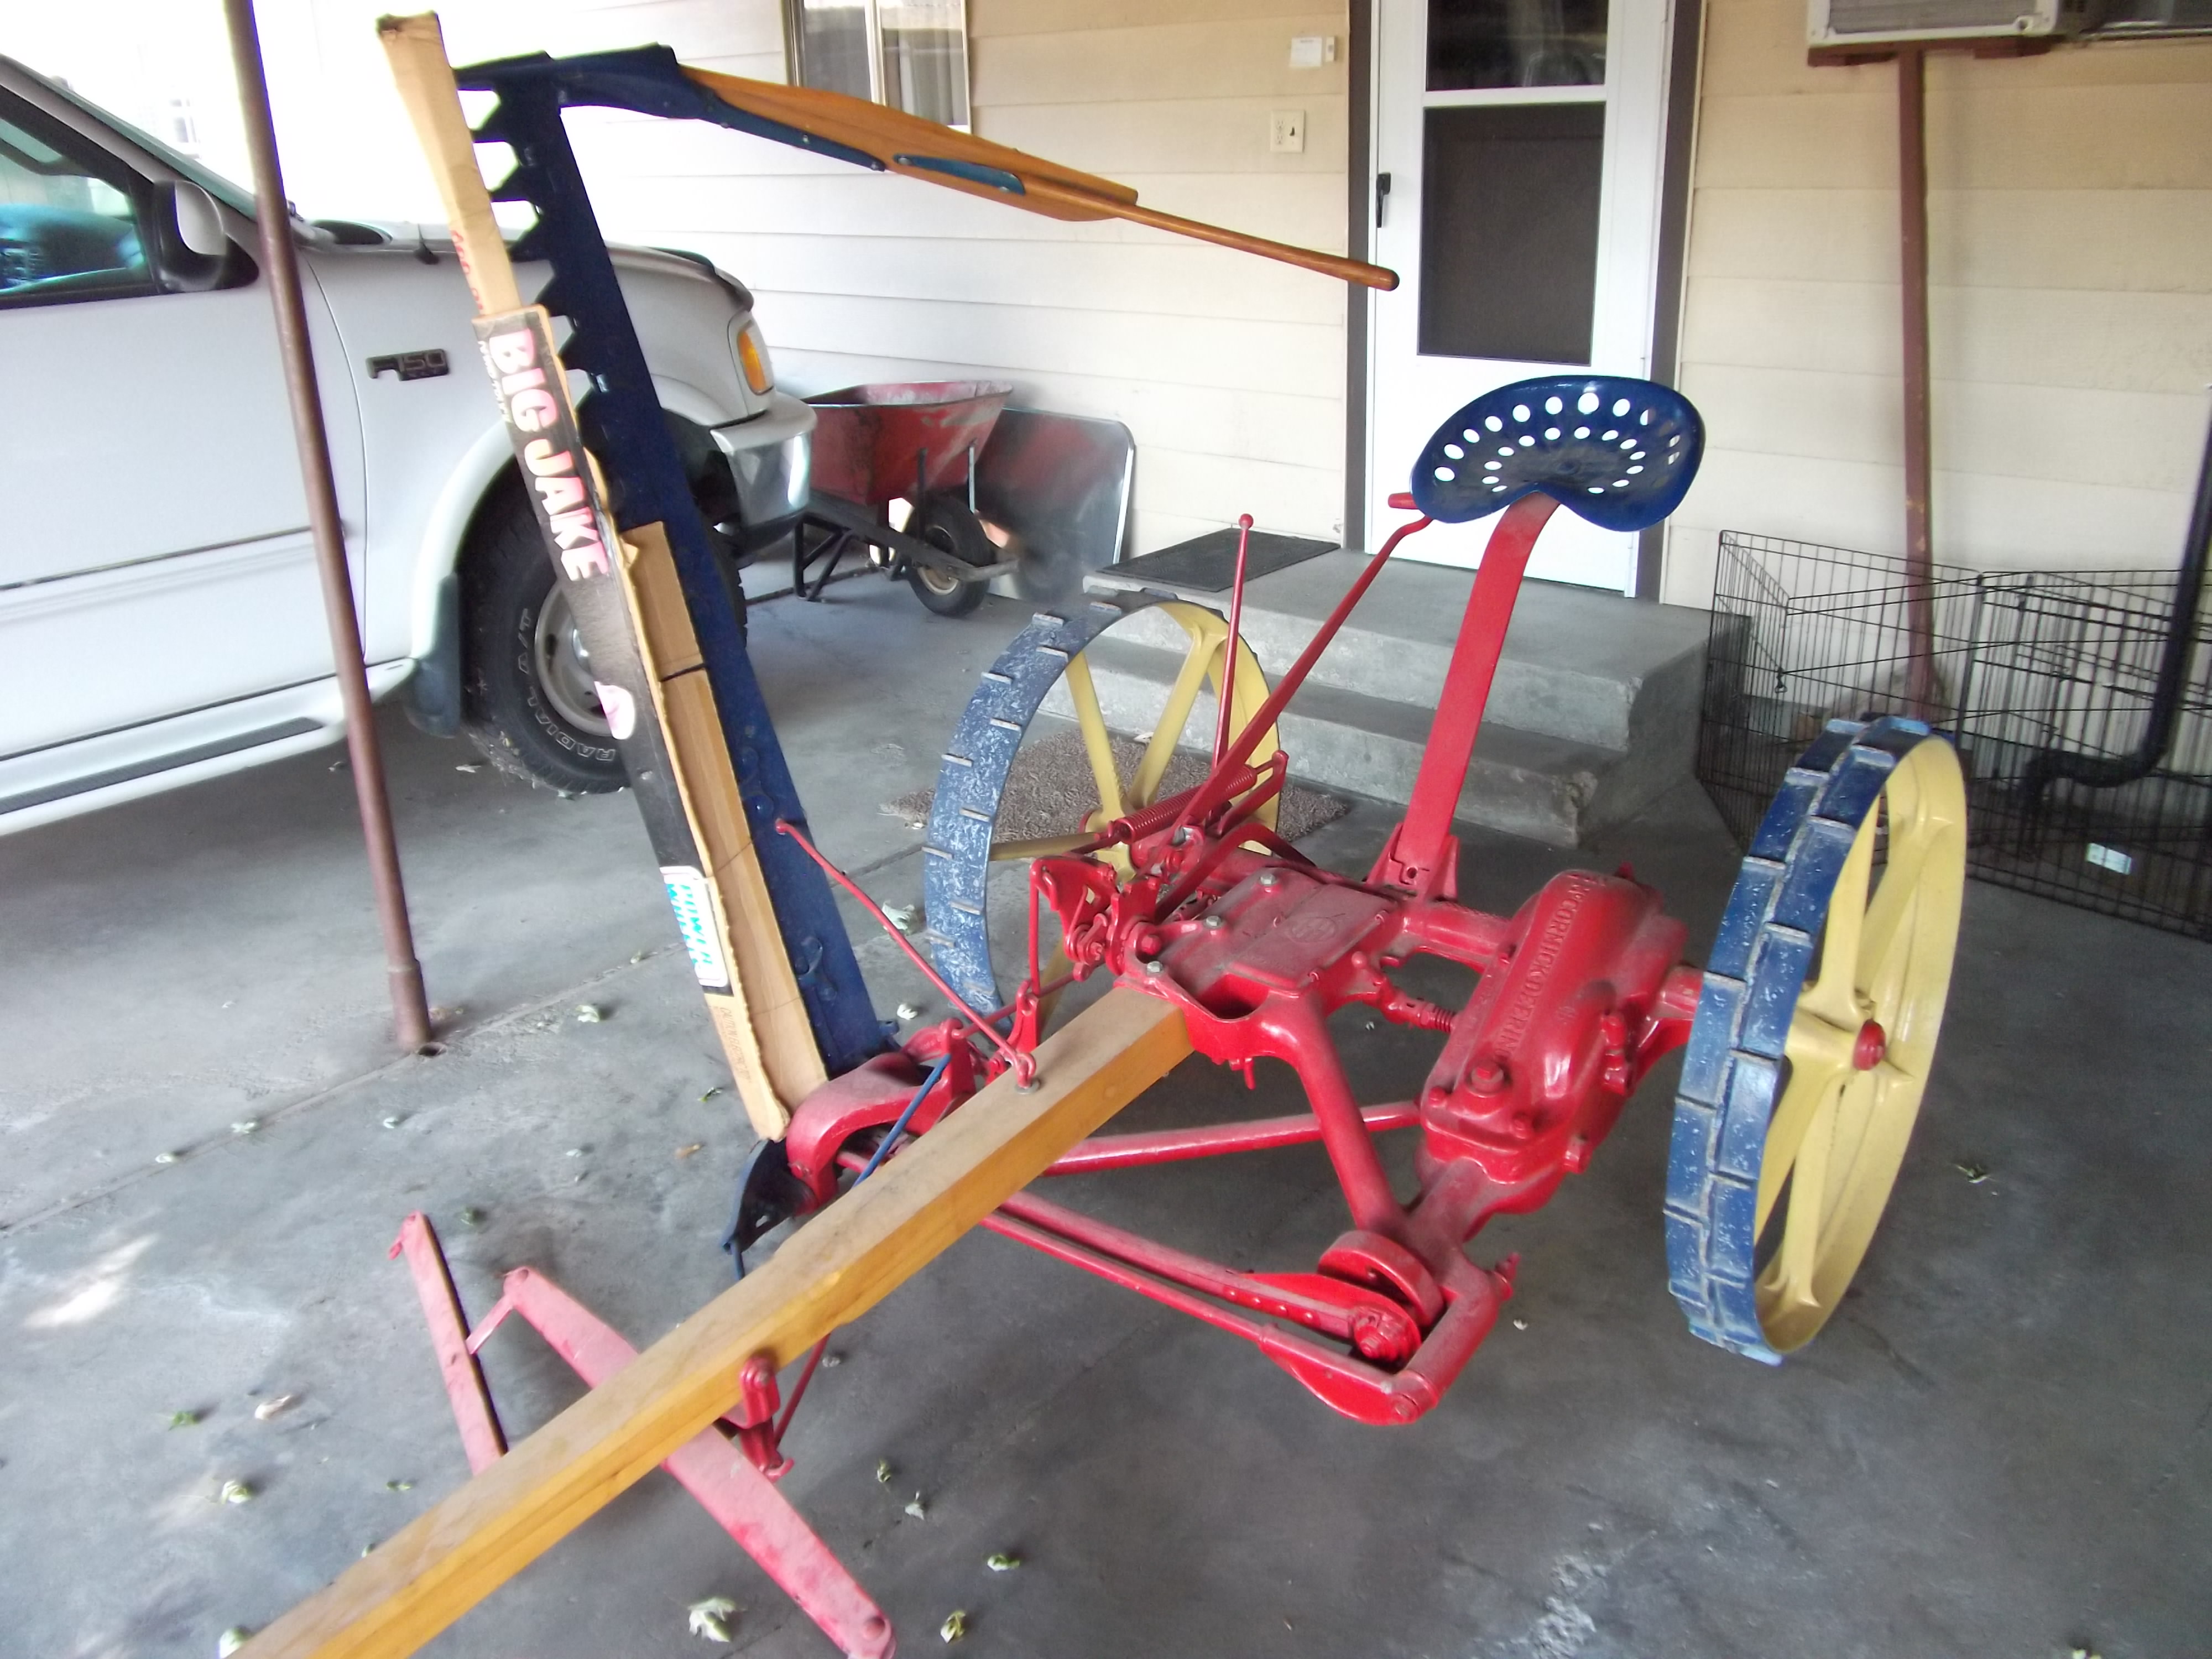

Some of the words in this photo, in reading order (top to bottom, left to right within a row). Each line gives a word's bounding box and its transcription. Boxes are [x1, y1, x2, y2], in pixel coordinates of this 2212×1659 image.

[489, 327, 557, 432] BIG
[524, 438, 608, 581] JAKE
[527, 686, 616, 761] RADIAL
